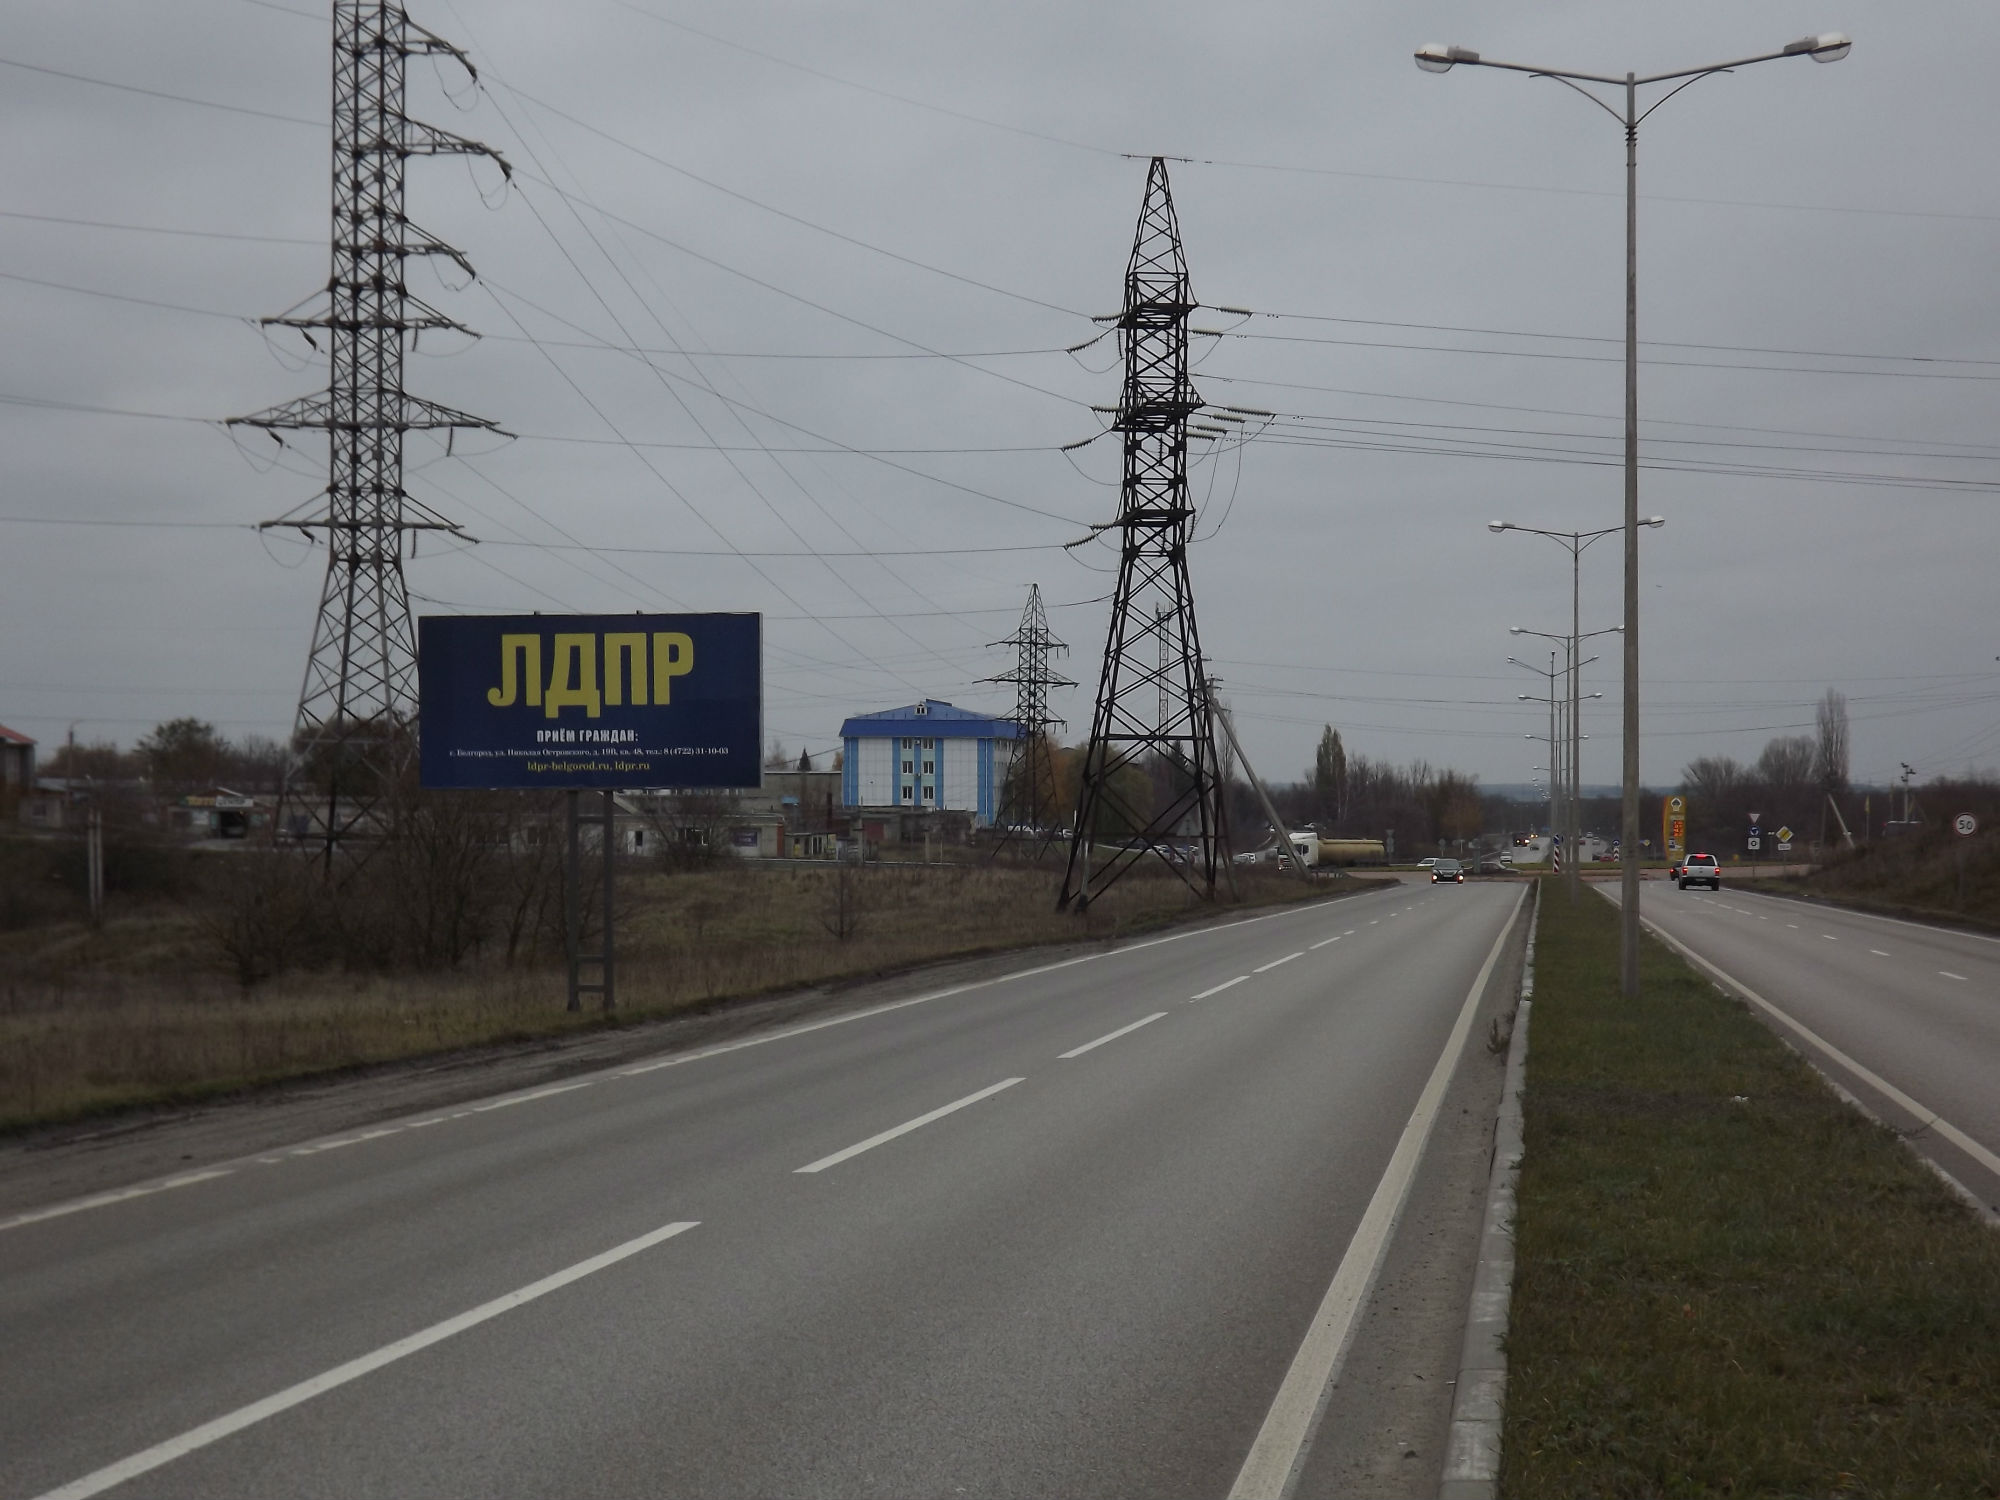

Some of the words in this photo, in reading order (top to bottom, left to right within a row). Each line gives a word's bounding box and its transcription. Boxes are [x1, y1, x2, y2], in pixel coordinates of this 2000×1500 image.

[487, 632, 694, 718] ЛДПР
[536, 728, 576, 743] ПРИЁМ
[579, 729, 639, 743] ГРАЖДАН:
[457, 749, 493, 758] Белгород,
[507, 748, 541, 756] Николая
[669, 747, 694, 756] (4722)
[695, 747, 729, 755] 31-10-03
[528, 761, 612, 772] ldpr-belgorod.ru,
[615, 760, 650, 771] ldpr.ru
[1959, 820, 1973, 830] 50
